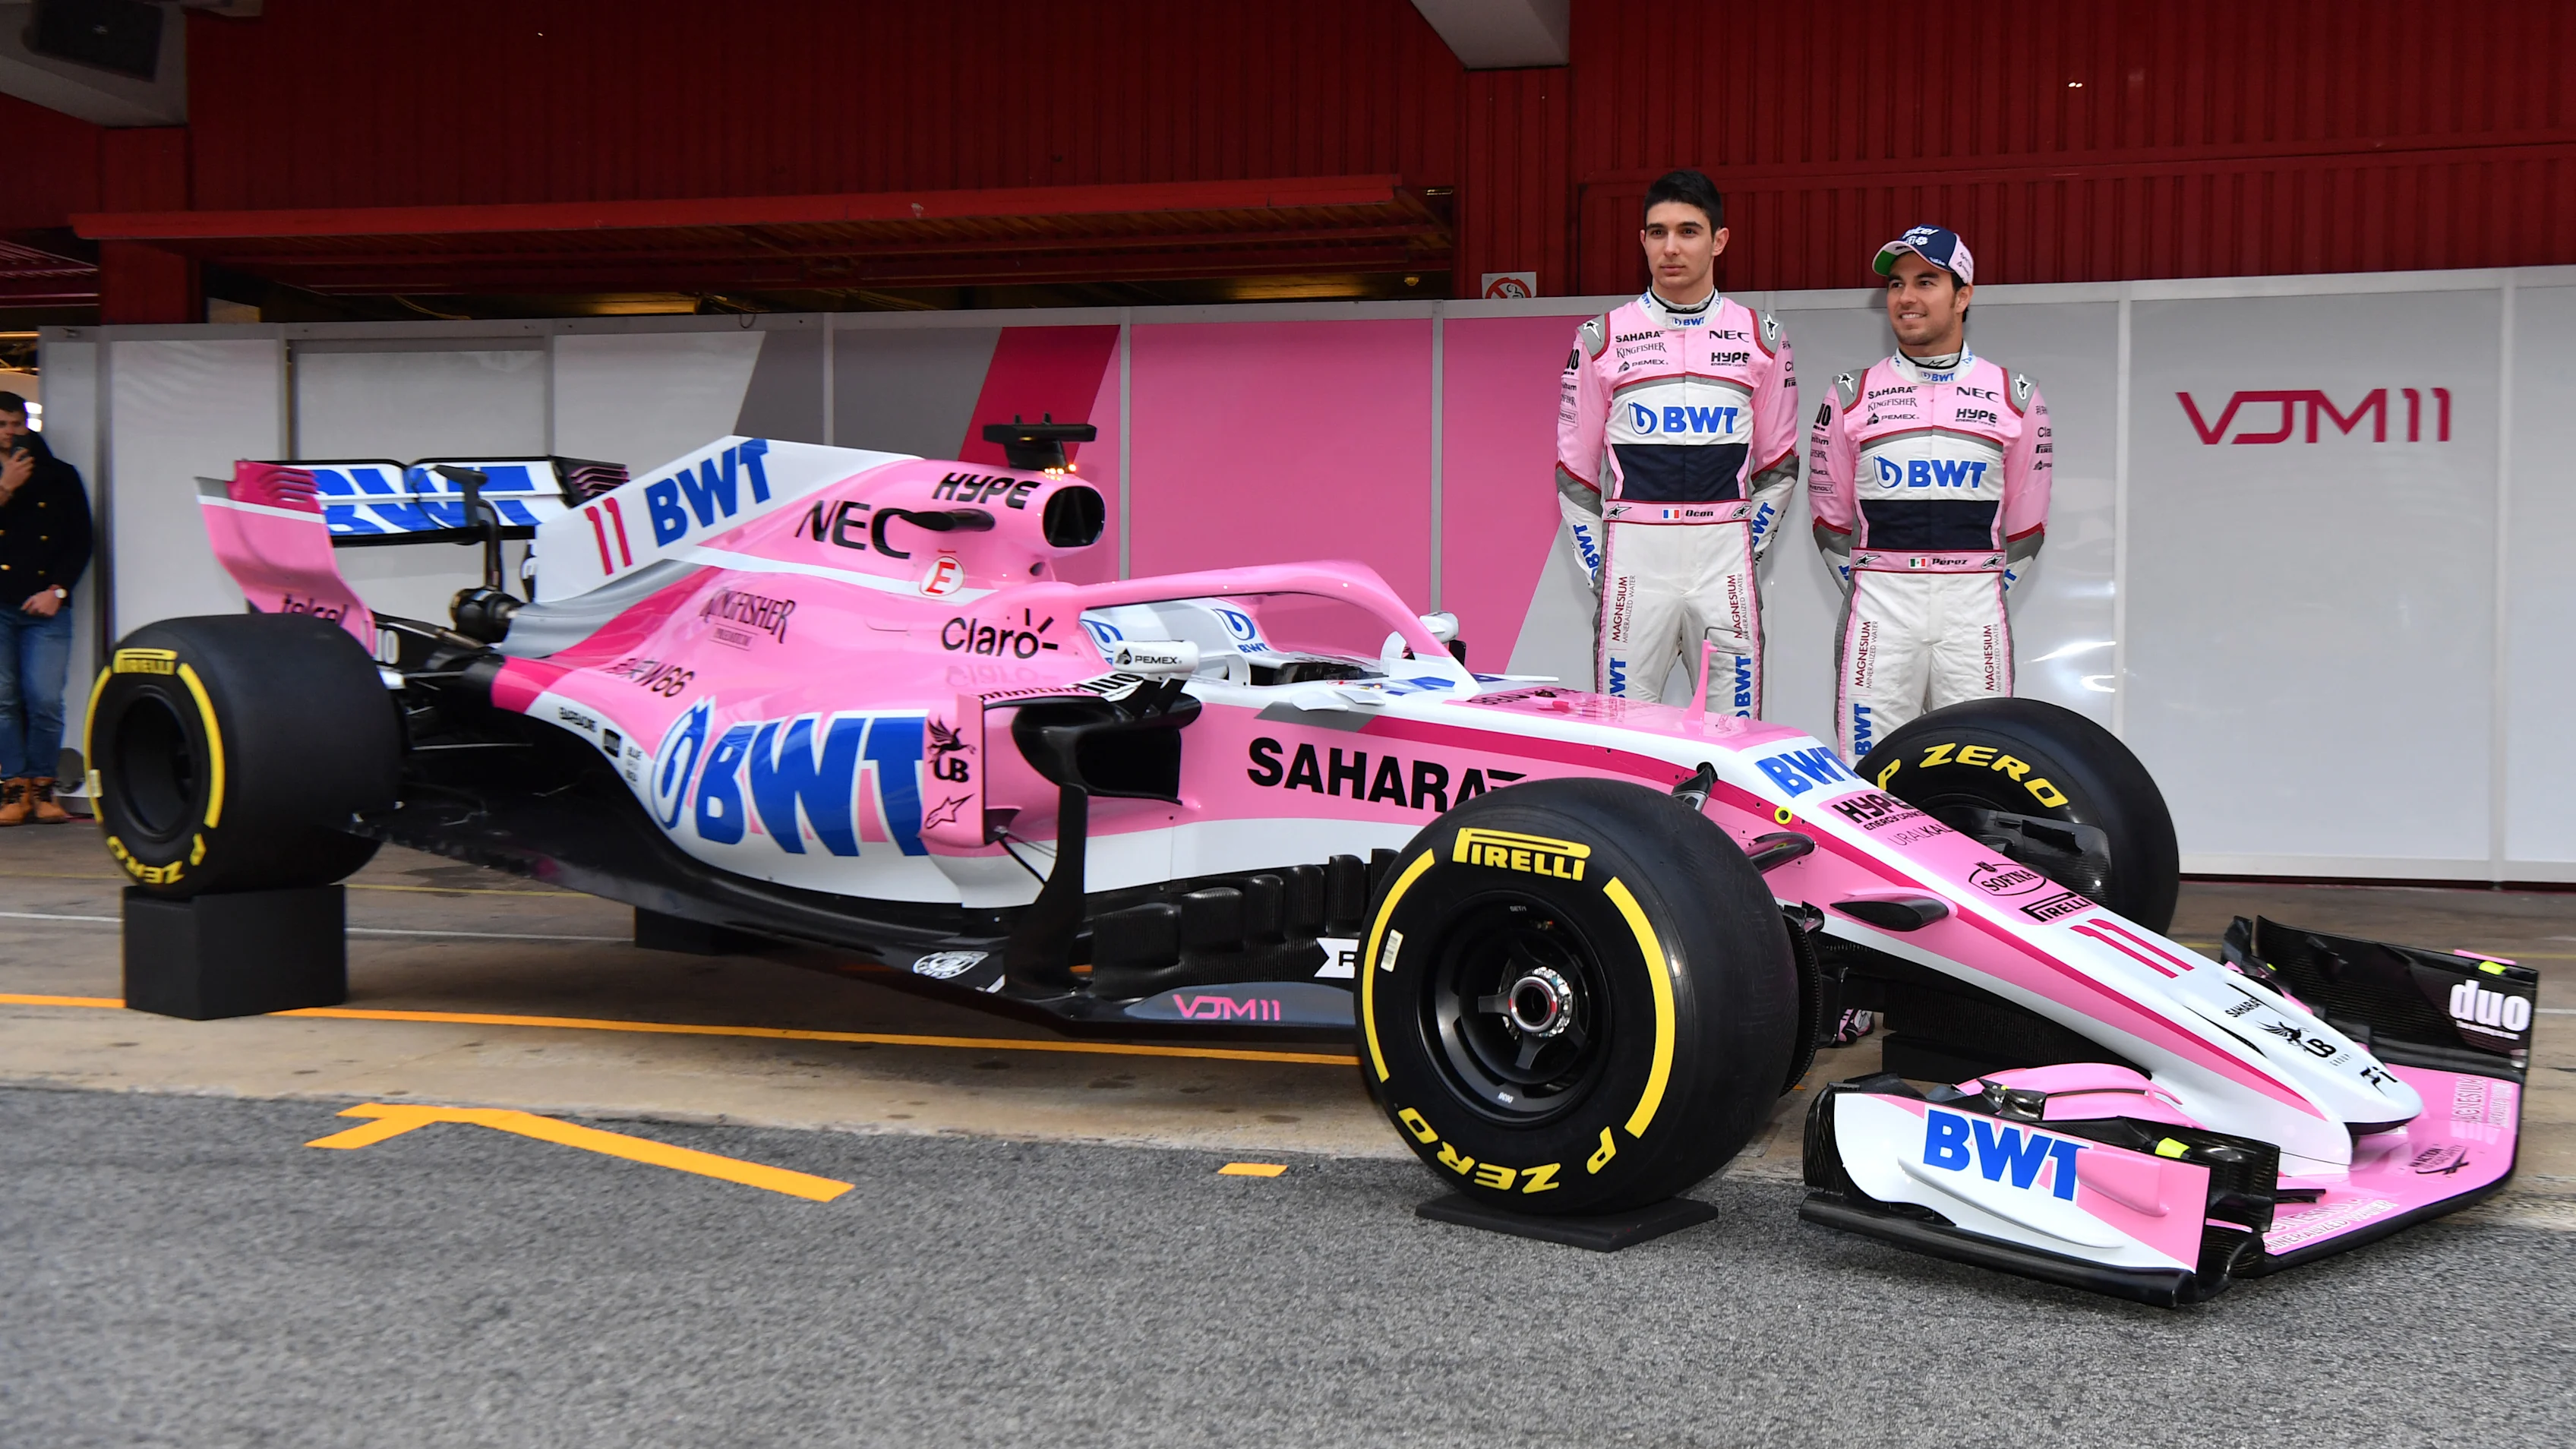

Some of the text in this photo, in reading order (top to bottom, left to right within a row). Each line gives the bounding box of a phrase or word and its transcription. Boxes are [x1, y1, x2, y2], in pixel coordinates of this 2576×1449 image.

[1615, 331, 1661, 343] SAHARA
[1684, 316, 1705, 326] BWT
[1709, 330, 1749, 343] NEC
[1616, 342, 1667, 358] KINGFISHER
[1632, 359, 1664, 368] PEMEX
[1712, 352, 1750, 364] HYPE
[1867, 387, 1913, 399] SAHARA
[1931, 372, 1955, 382] BWT
[1956, 387, 1999, 402] NEC
[1663, 406, 1738, 434] BWT
[1867, 397, 1918, 412] KINGFISHER
[1956, 408, 1997, 424] HYPE
[931, 472, 1043, 510] HYPE
[1908, 460, 1987, 488] BWT
[645, 437, 772, 548] BWT
[584, 497, 633, 576] 11
[795, 499, 911, 559] NEC
[1574, 525, 1600, 569] BWT
[924, 561, 956, 595] E
[1932, 557, 1968, 566] Pérez
[1612, 576, 1627, 641] MAGNESIUM
[1622, 596, 1634, 644] MINERALIZED
[1727, 575, 1742, 639] MAGNESIUM
[942, 617, 1039, 659] Claro
[1237, 643, 1269, 653] BWT
[1855, 620, 1871, 687] MAGNESIUM
[1135, 655, 1178, 665] PEMEX
[1866, 643, 1876, 689] MINERALIZED
[1983, 624, 1994, 691] MAGNESIUM
[1735, 656, 1751, 707] BWT
[1854, 703, 1872, 756] BWT
[695, 715, 929, 857] BWT
[933, 758, 969, 783] UB
[1247, 737, 1496, 812] SAHARA
[1877, 743, 2069, 808] P ZERO
[1831, 792, 1916, 824] HYPE
[1863, 816, 1899, 831] ENERGY
[106, 833, 206, 884] P ZERO
[1452, 827, 1591, 881] PIRELLI
[1981, 869, 2039, 892] SOFINA
[2019, 891, 2093, 922] PIRELLI
[2069, 918, 2195, 978] 11
[2225, 998, 2262, 1018] SAHARA
[2449, 979, 2531, 1031] duo
[1397, 1106, 1617, 1195] P ZERO
[1923, 1109, 2089, 1201] BWT
